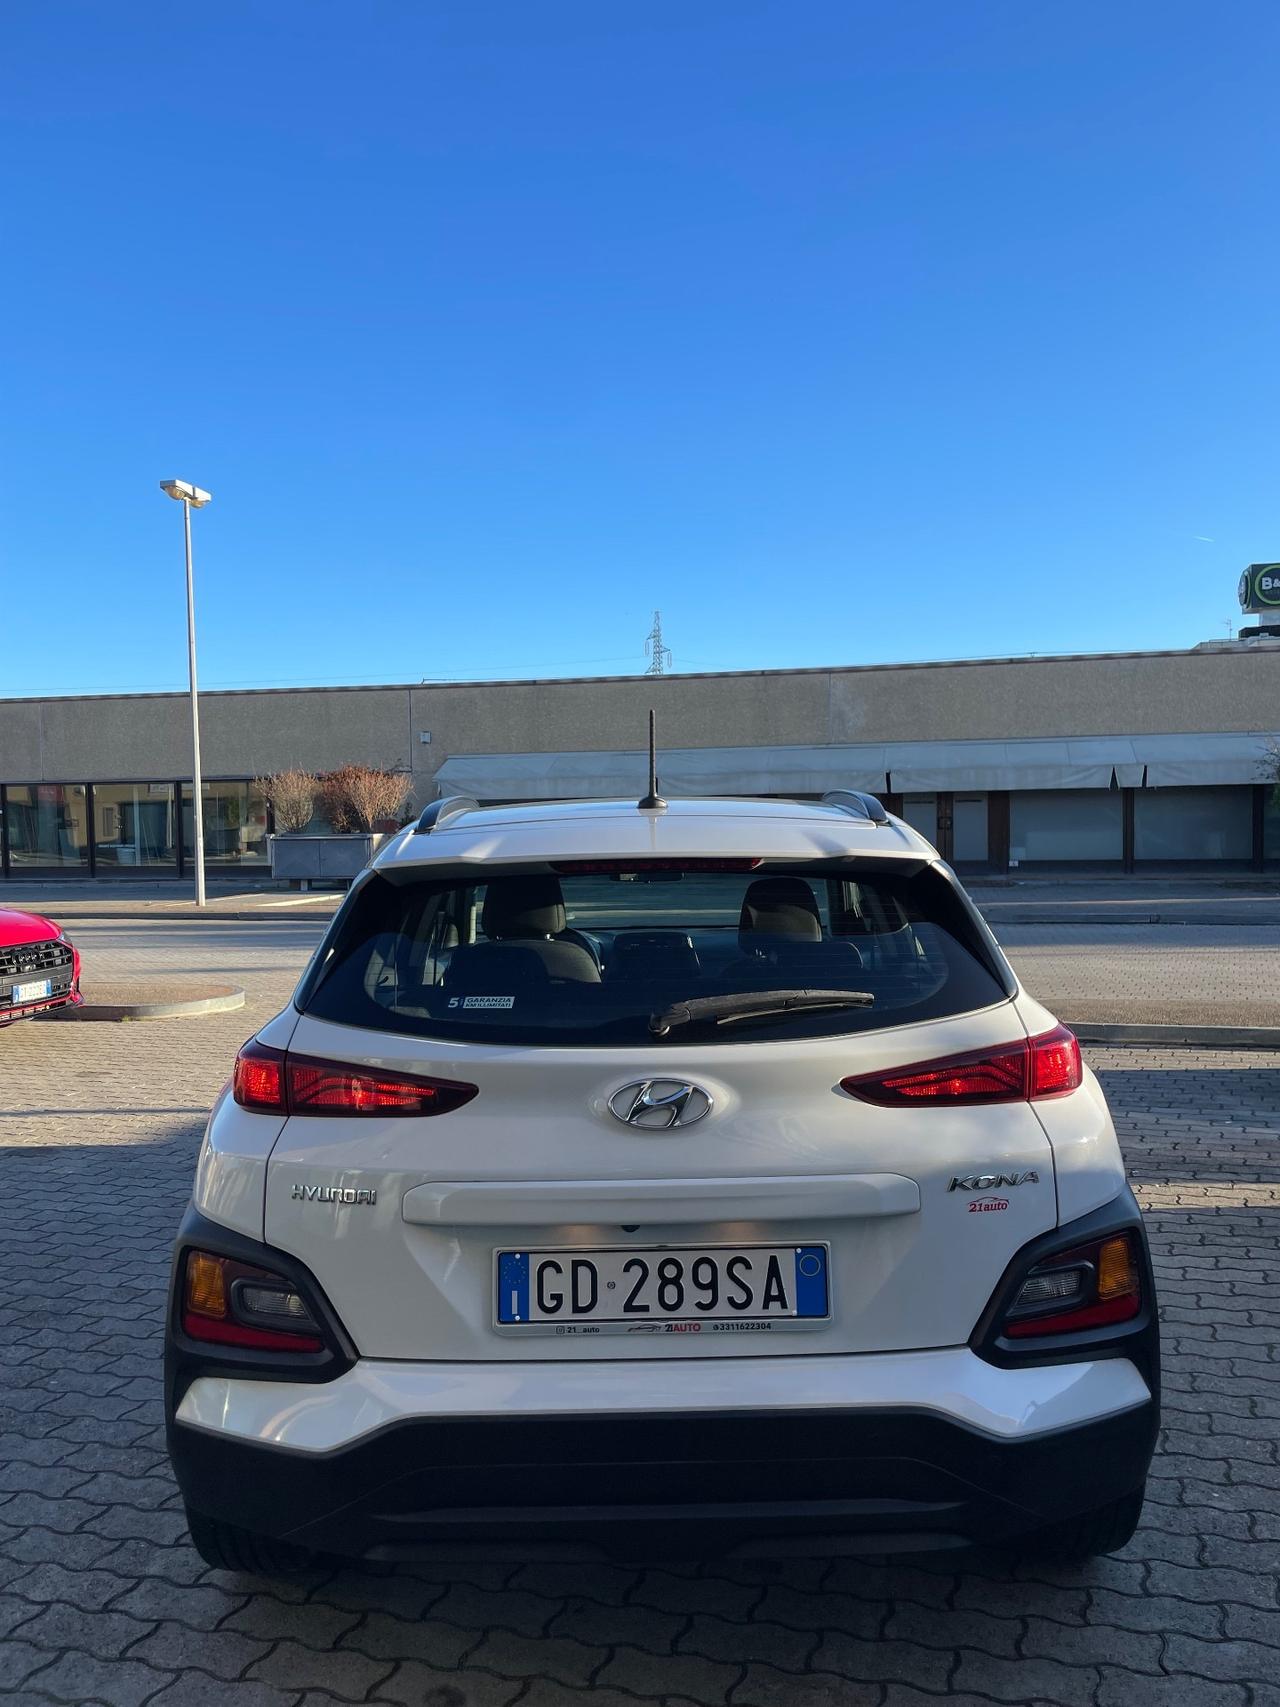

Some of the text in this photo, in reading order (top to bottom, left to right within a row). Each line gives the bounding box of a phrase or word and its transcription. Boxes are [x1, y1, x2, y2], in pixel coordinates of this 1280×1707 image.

[448, 997, 460, 1008] 5
[946, 1171, 1040, 1192] KONA
[291, 1184, 377, 1206] HYUNDAI
[968, 1201, 1008, 1212] 21auto
[536, 1255, 788, 1314] GD 289SA
[664, 1323, 701, 1333] 21AUTO
